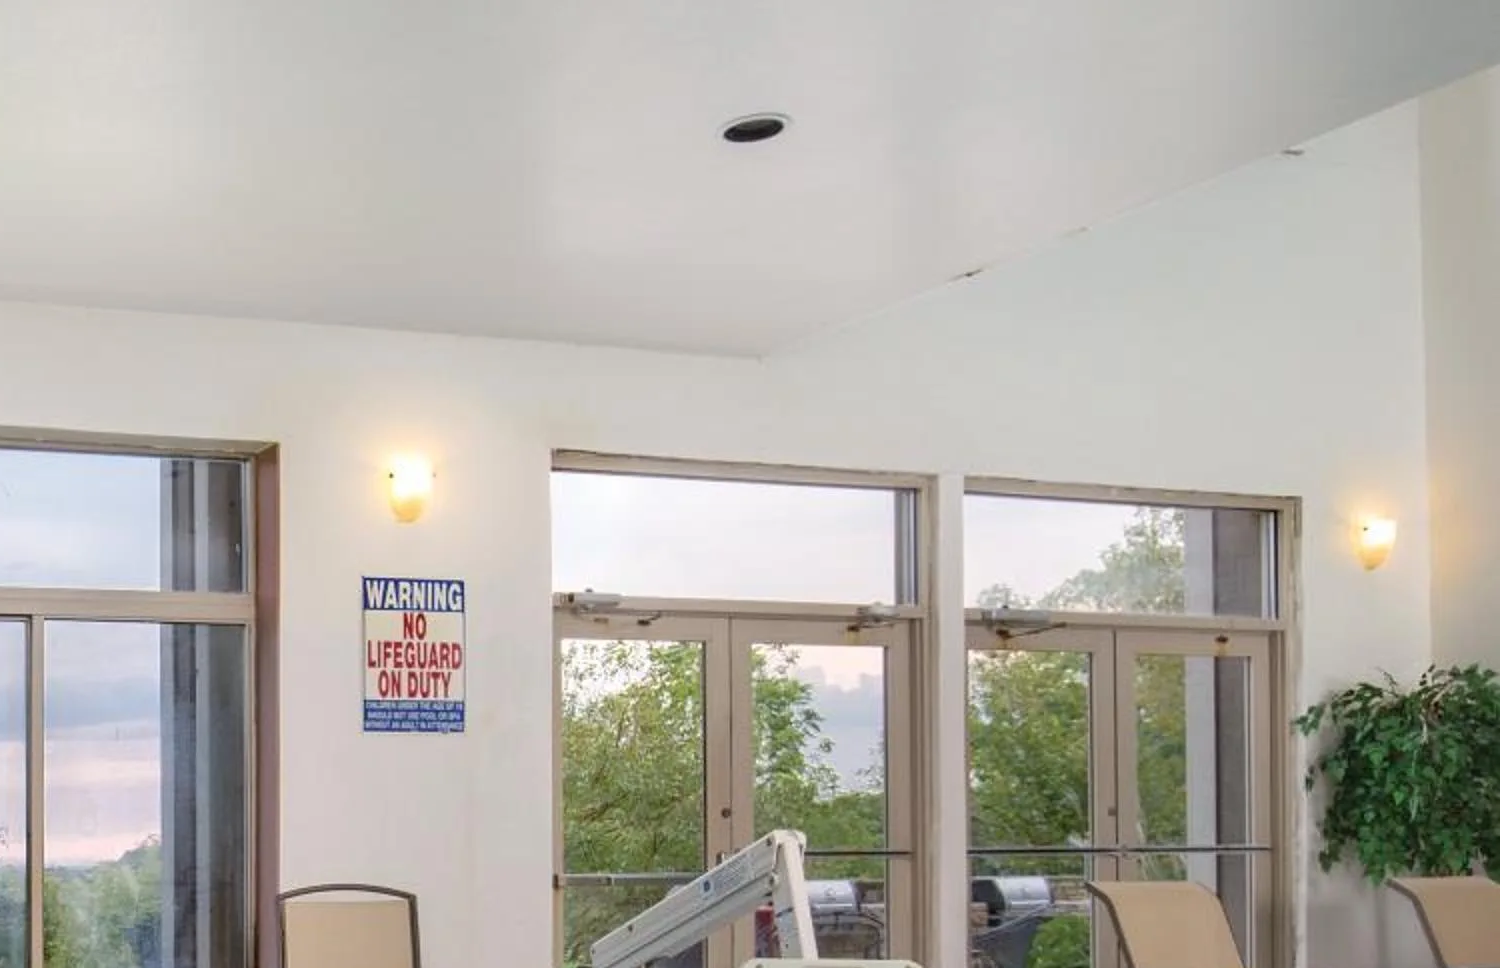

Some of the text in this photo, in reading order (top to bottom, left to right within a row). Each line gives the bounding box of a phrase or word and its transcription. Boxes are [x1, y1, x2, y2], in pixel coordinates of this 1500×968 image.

[365, 580, 462, 610] WARNING
[403, 612, 427, 640] NO
[367, 640, 462, 669] LIFEGUARD
[378, 670, 453, 698] ON DUTY
